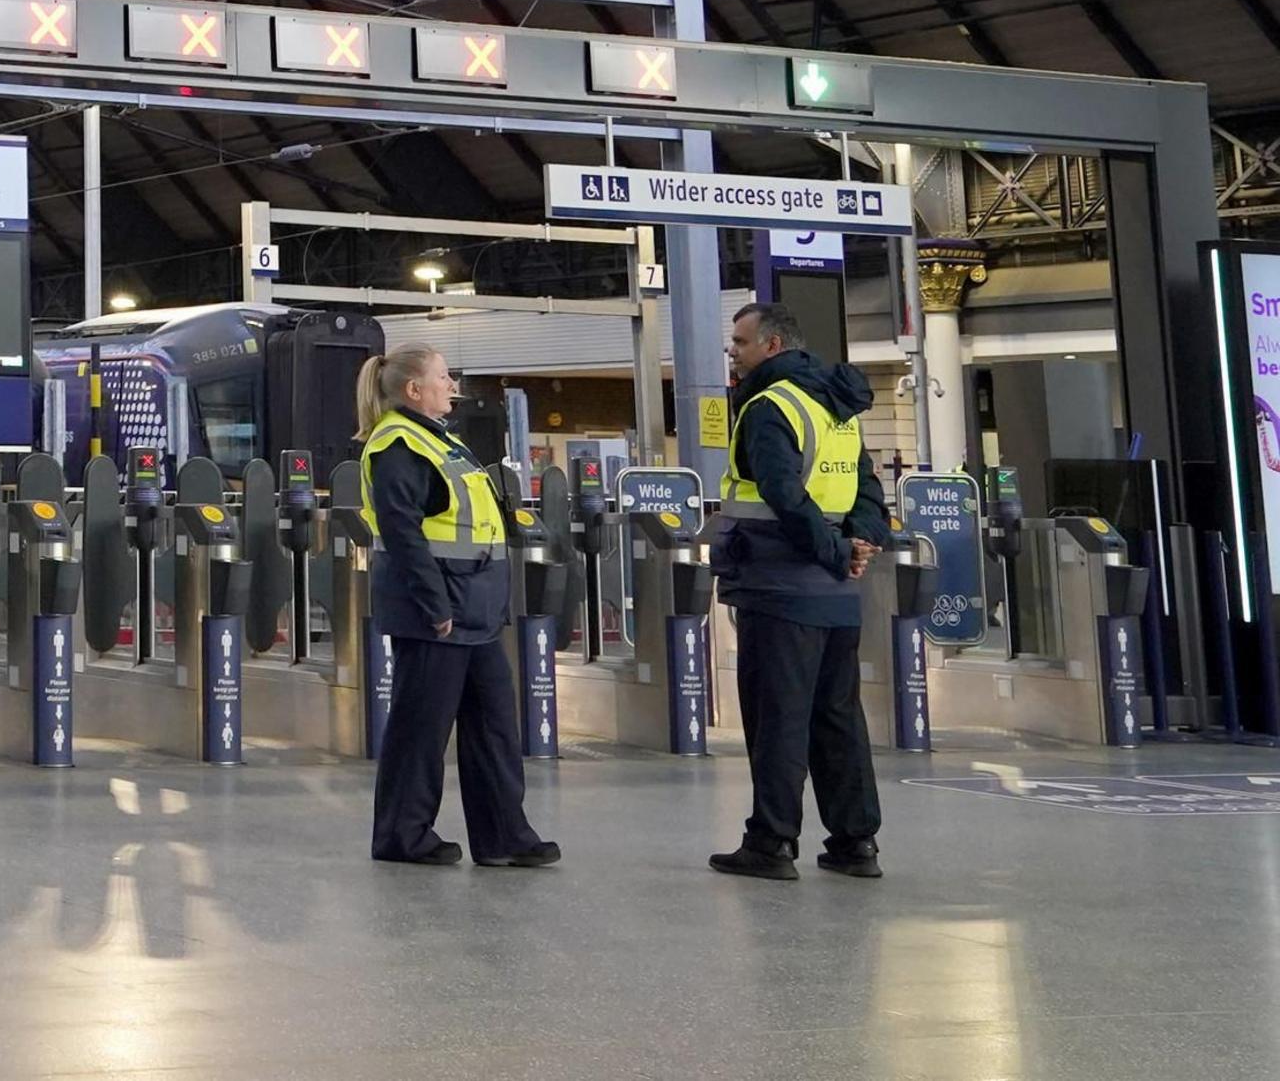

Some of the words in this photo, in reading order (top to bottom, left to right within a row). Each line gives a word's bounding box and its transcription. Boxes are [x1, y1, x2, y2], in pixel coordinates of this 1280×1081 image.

[648, 177, 708, 204] Wider
[713, 185, 776, 207] access
[781, 188, 824, 213] gate
[258, 247, 271, 269] 6
[789, 257, 826, 268] Departures
[645, 265, 656, 286] 7
[639, 483, 672, 499] Wide
[926, 487, 958, 502] Wide
[640, 500, 682, 513] access
[920, 503, 960, 517] access
[932, 517, 960, 533] gate
